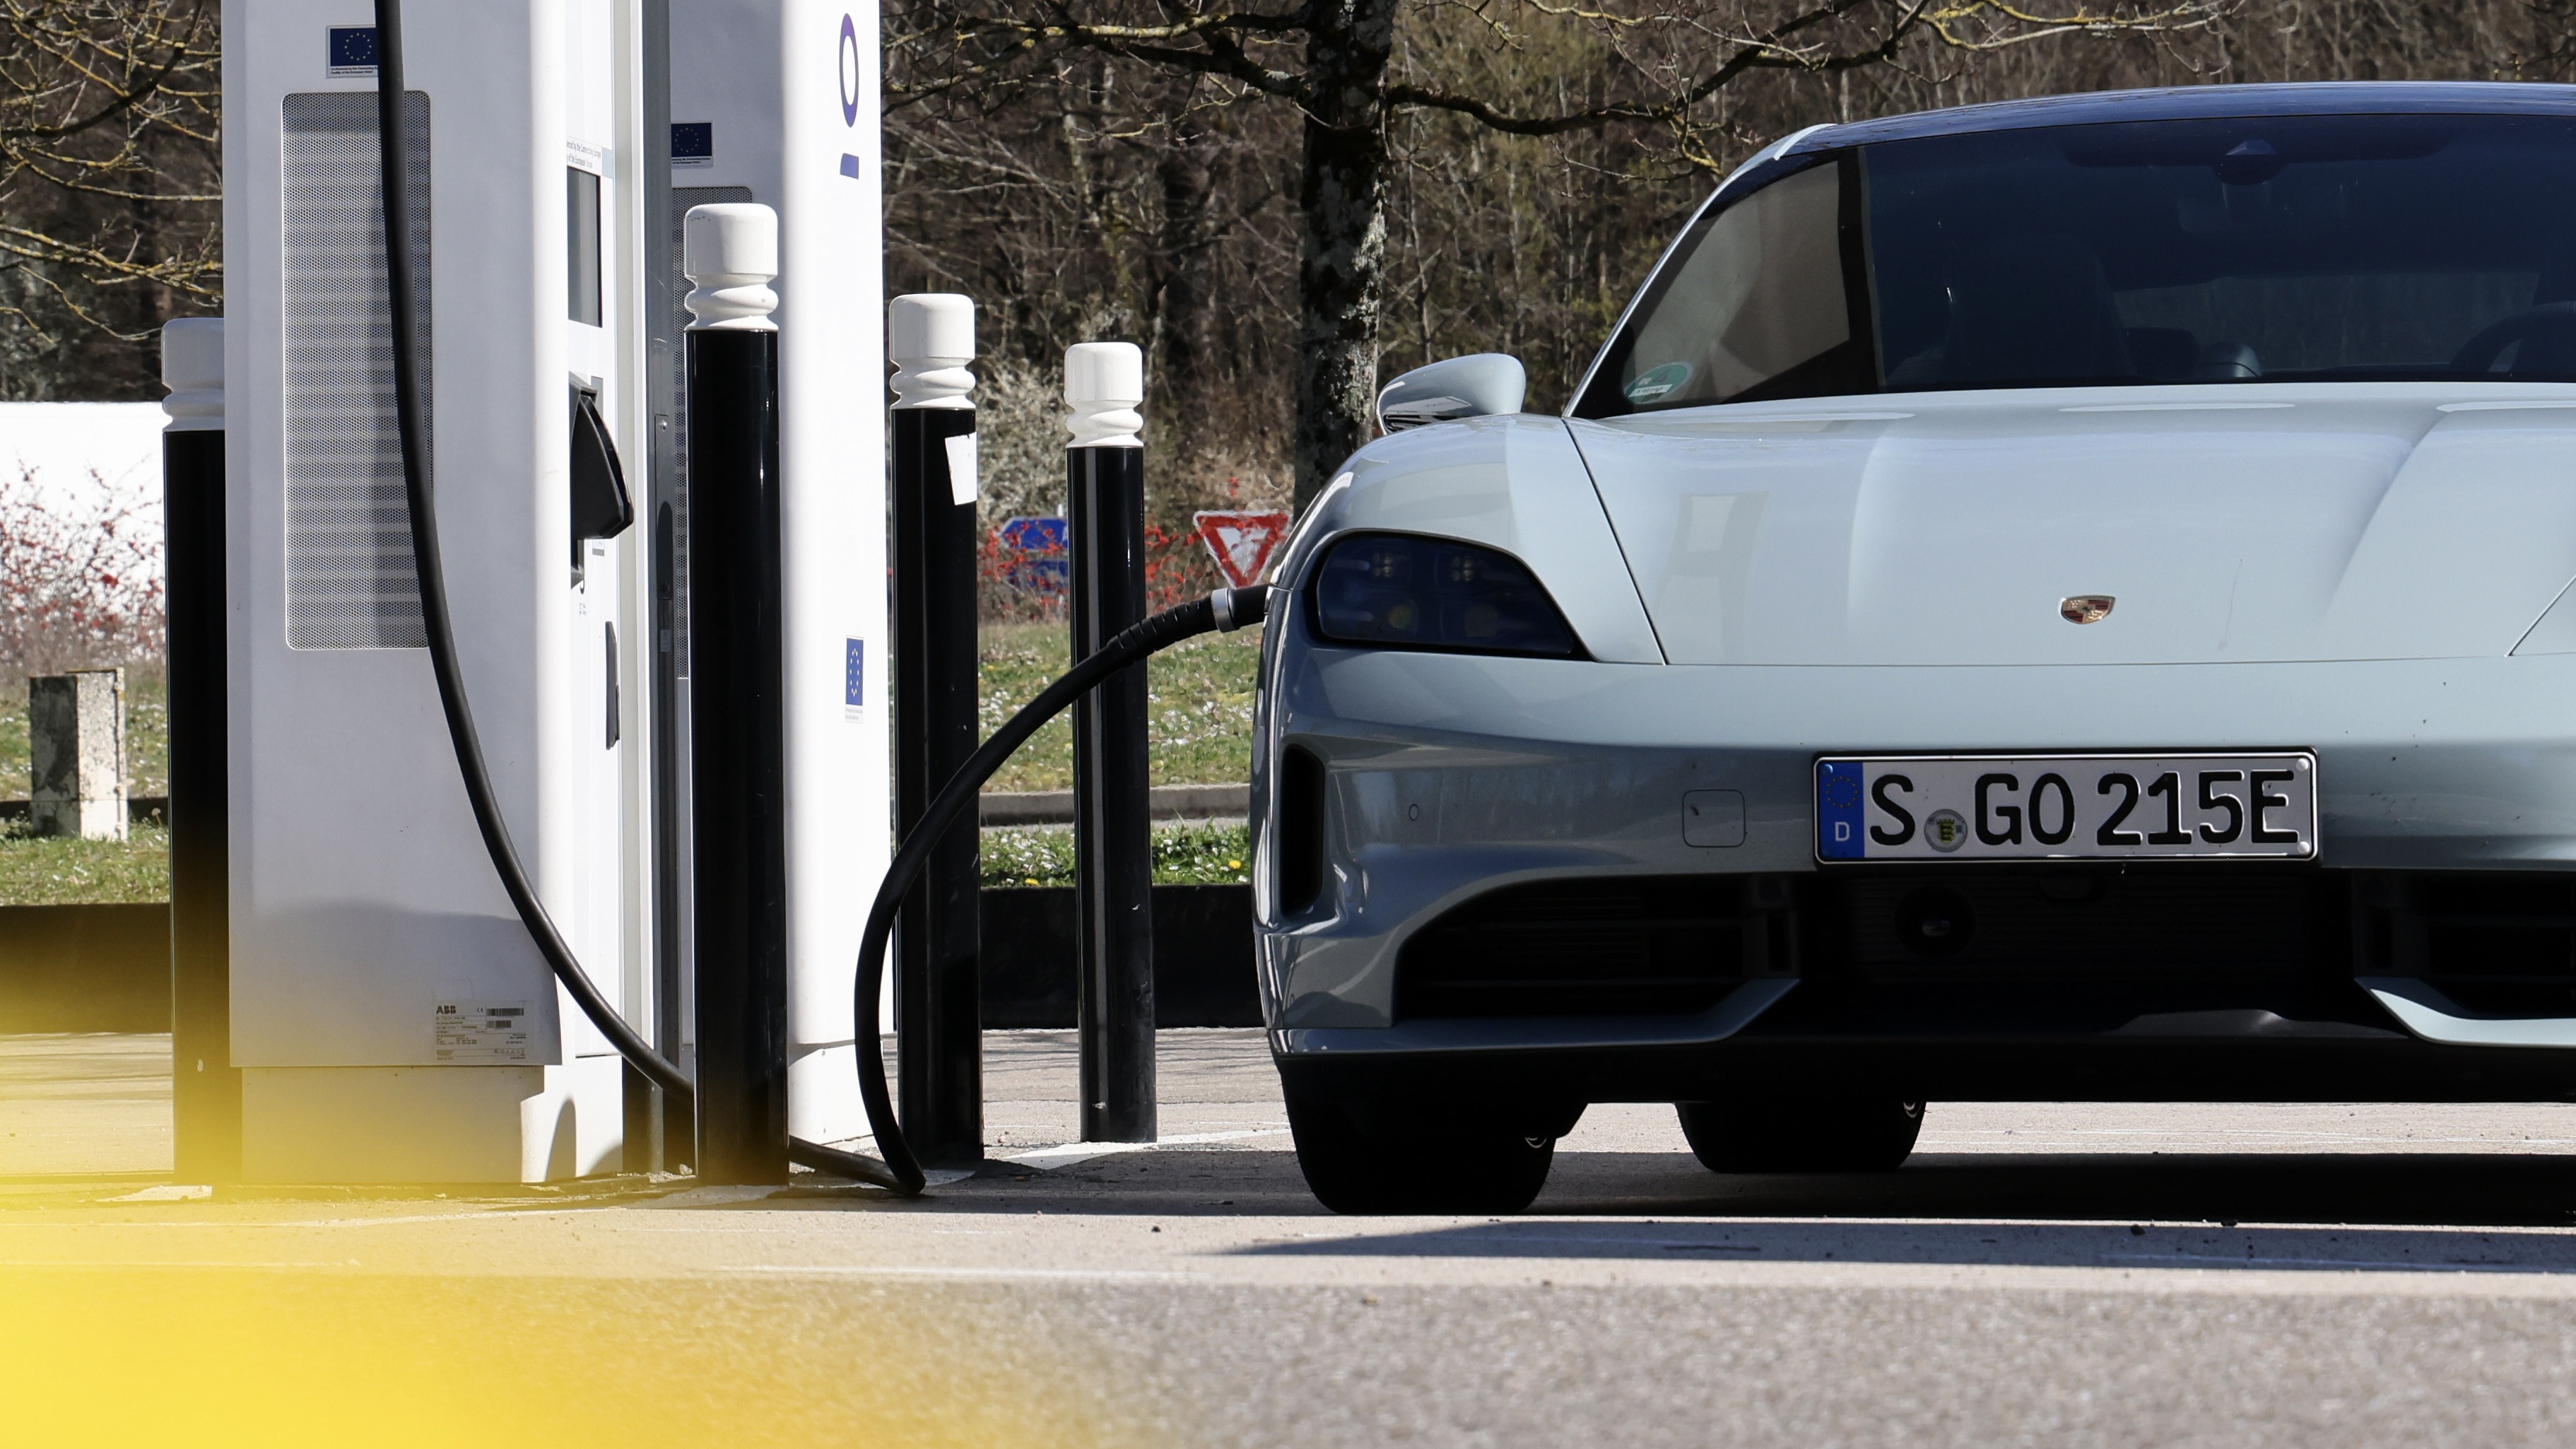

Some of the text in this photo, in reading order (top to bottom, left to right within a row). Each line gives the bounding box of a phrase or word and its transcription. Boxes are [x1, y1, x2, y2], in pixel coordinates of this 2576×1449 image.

[1870, 769, 2299, 846] S GO 215E
[1835, 821, 1850, 842] D
[436, 1005, 457, 1014] ABB
